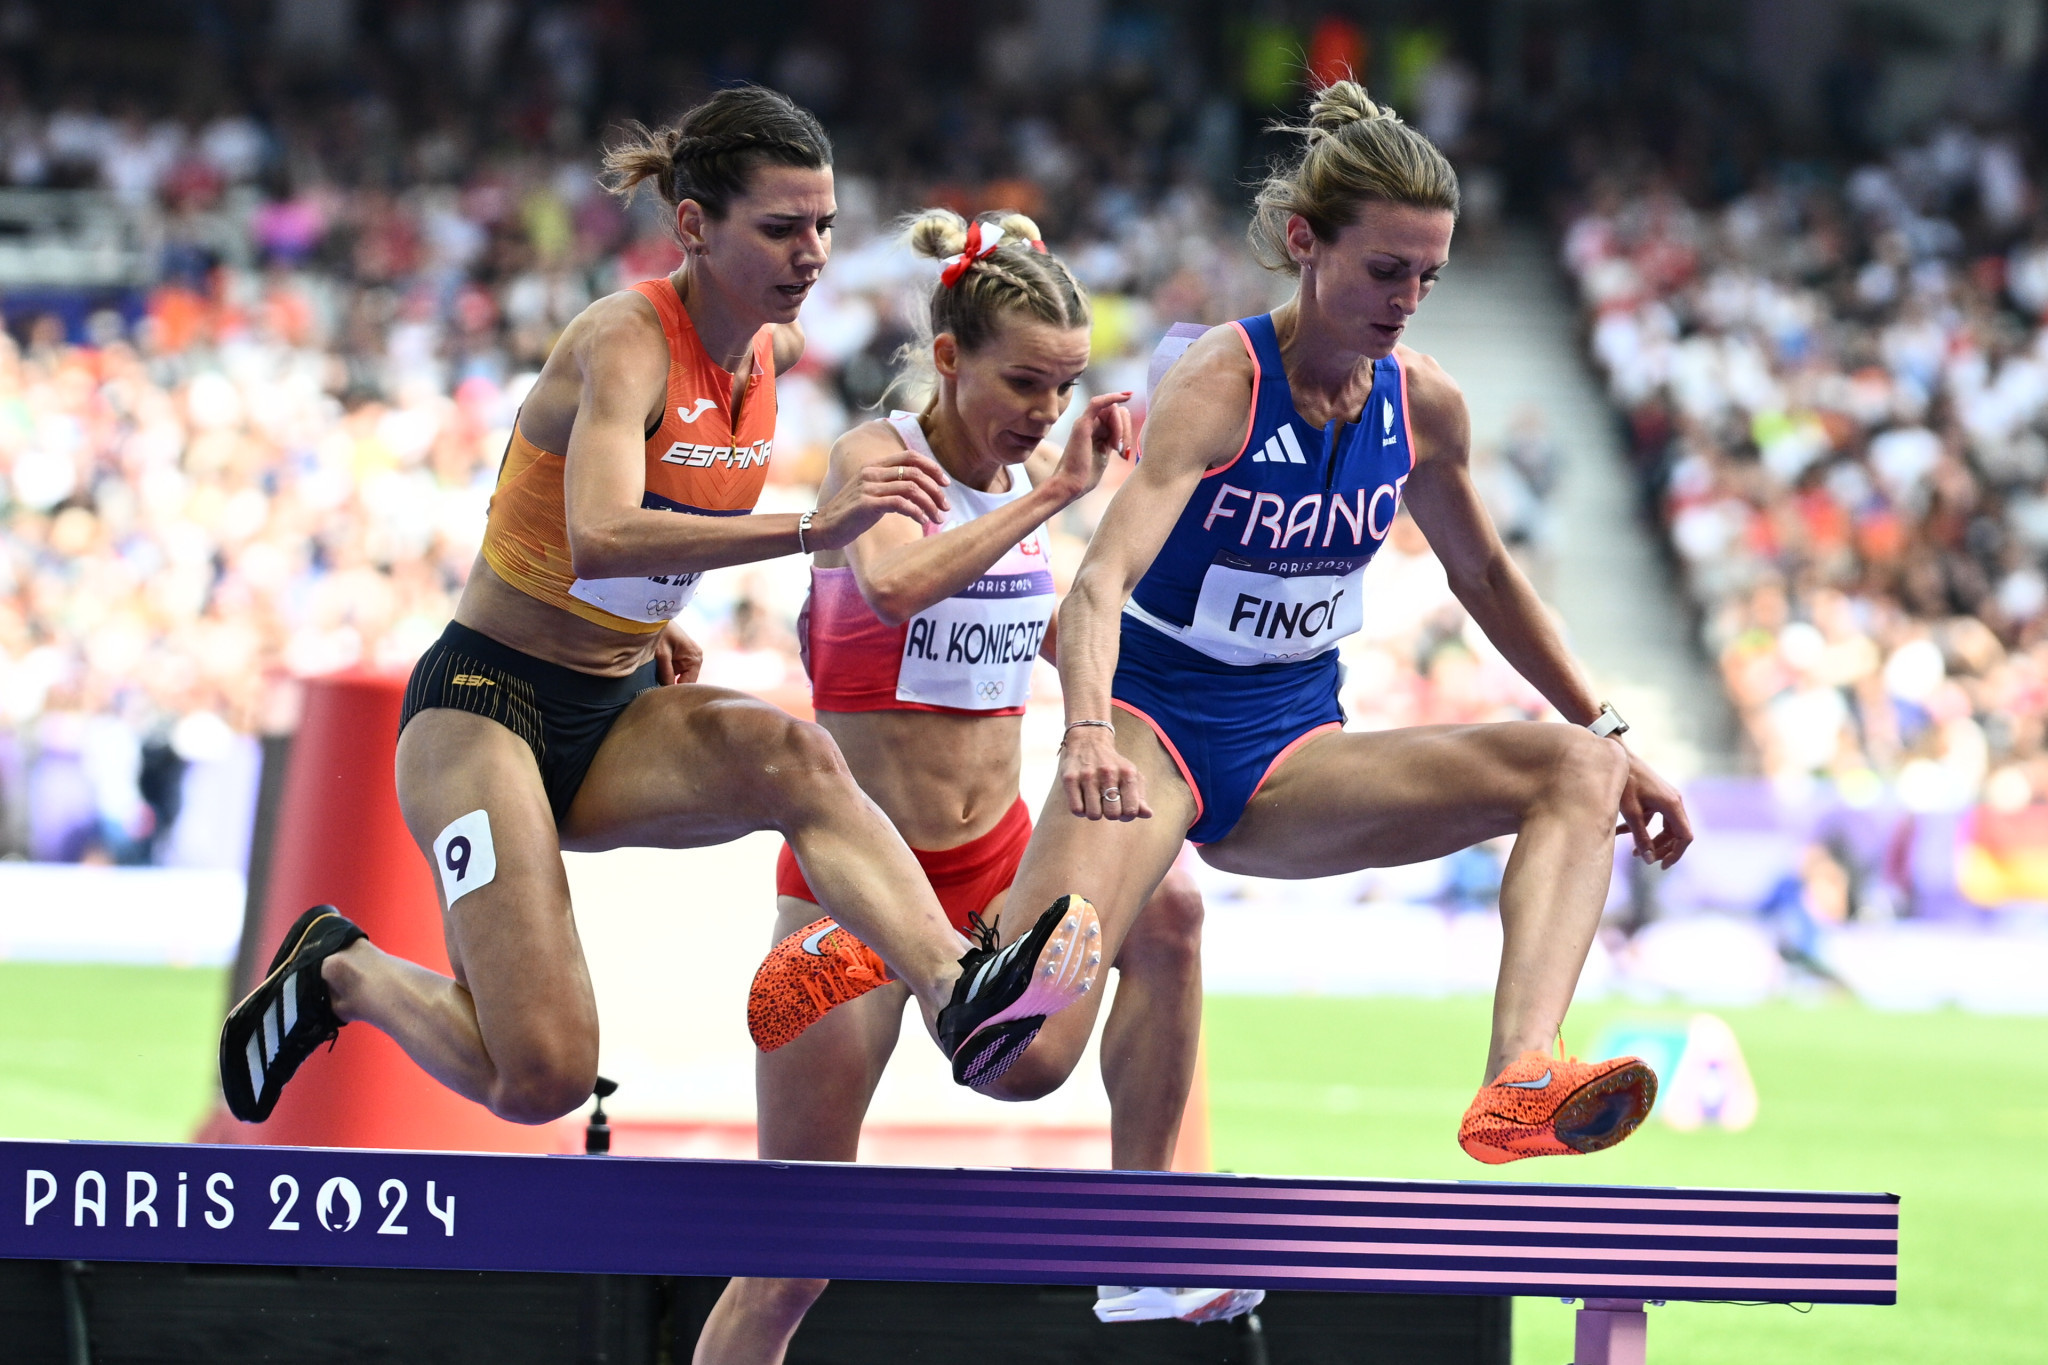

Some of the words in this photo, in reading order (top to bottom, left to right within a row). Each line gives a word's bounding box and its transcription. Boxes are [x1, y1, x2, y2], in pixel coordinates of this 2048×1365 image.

[1315, 560, 1353, 570] 2024
[1229, 589, 1344, 639] FINOT
[446, 835, 471, 882] 9
[268, 1174, 456, 1237] 2024
